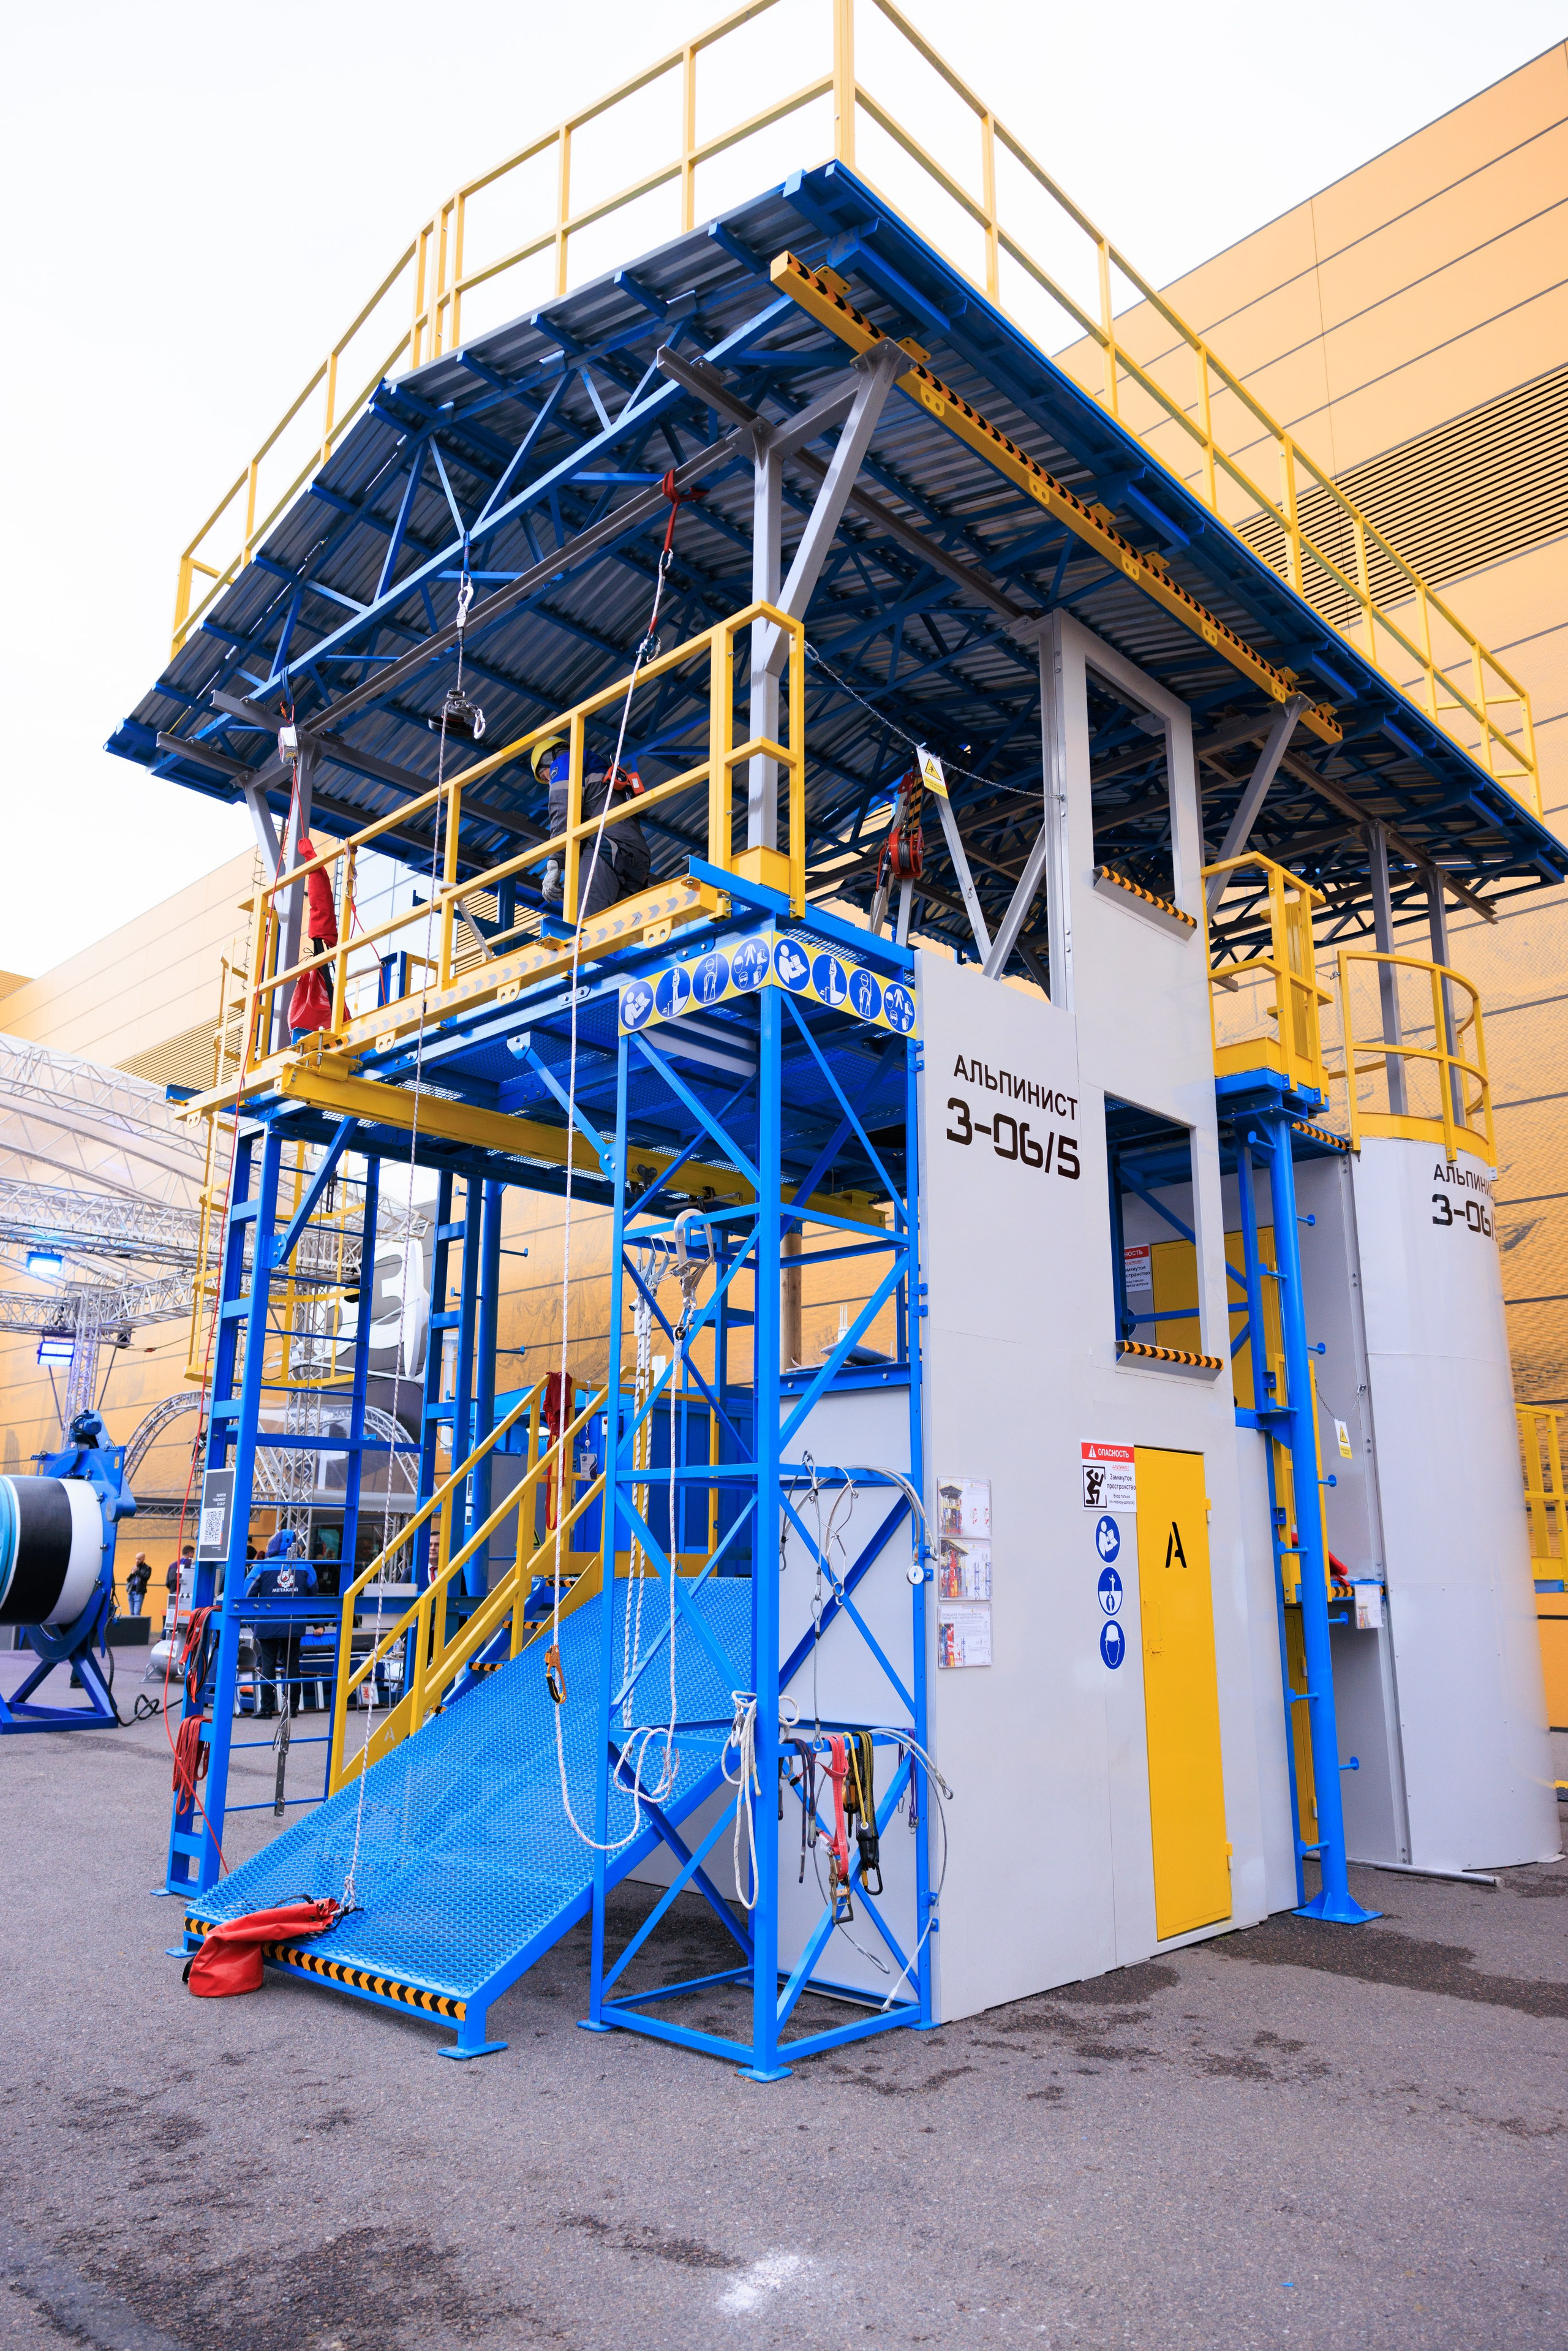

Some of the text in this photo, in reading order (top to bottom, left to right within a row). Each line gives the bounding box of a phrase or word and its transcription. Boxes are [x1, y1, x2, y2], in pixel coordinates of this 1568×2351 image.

[953, 1054, 1078, 1120] АЛЬПИНИСТ
[946, 1097, 1080, 1180] 3-06/5
[1433, 1164, 1494, 1201] АЛЬПИНИС
[1098, 1448, 1129, 1458] ОПАСНОСТЬ
